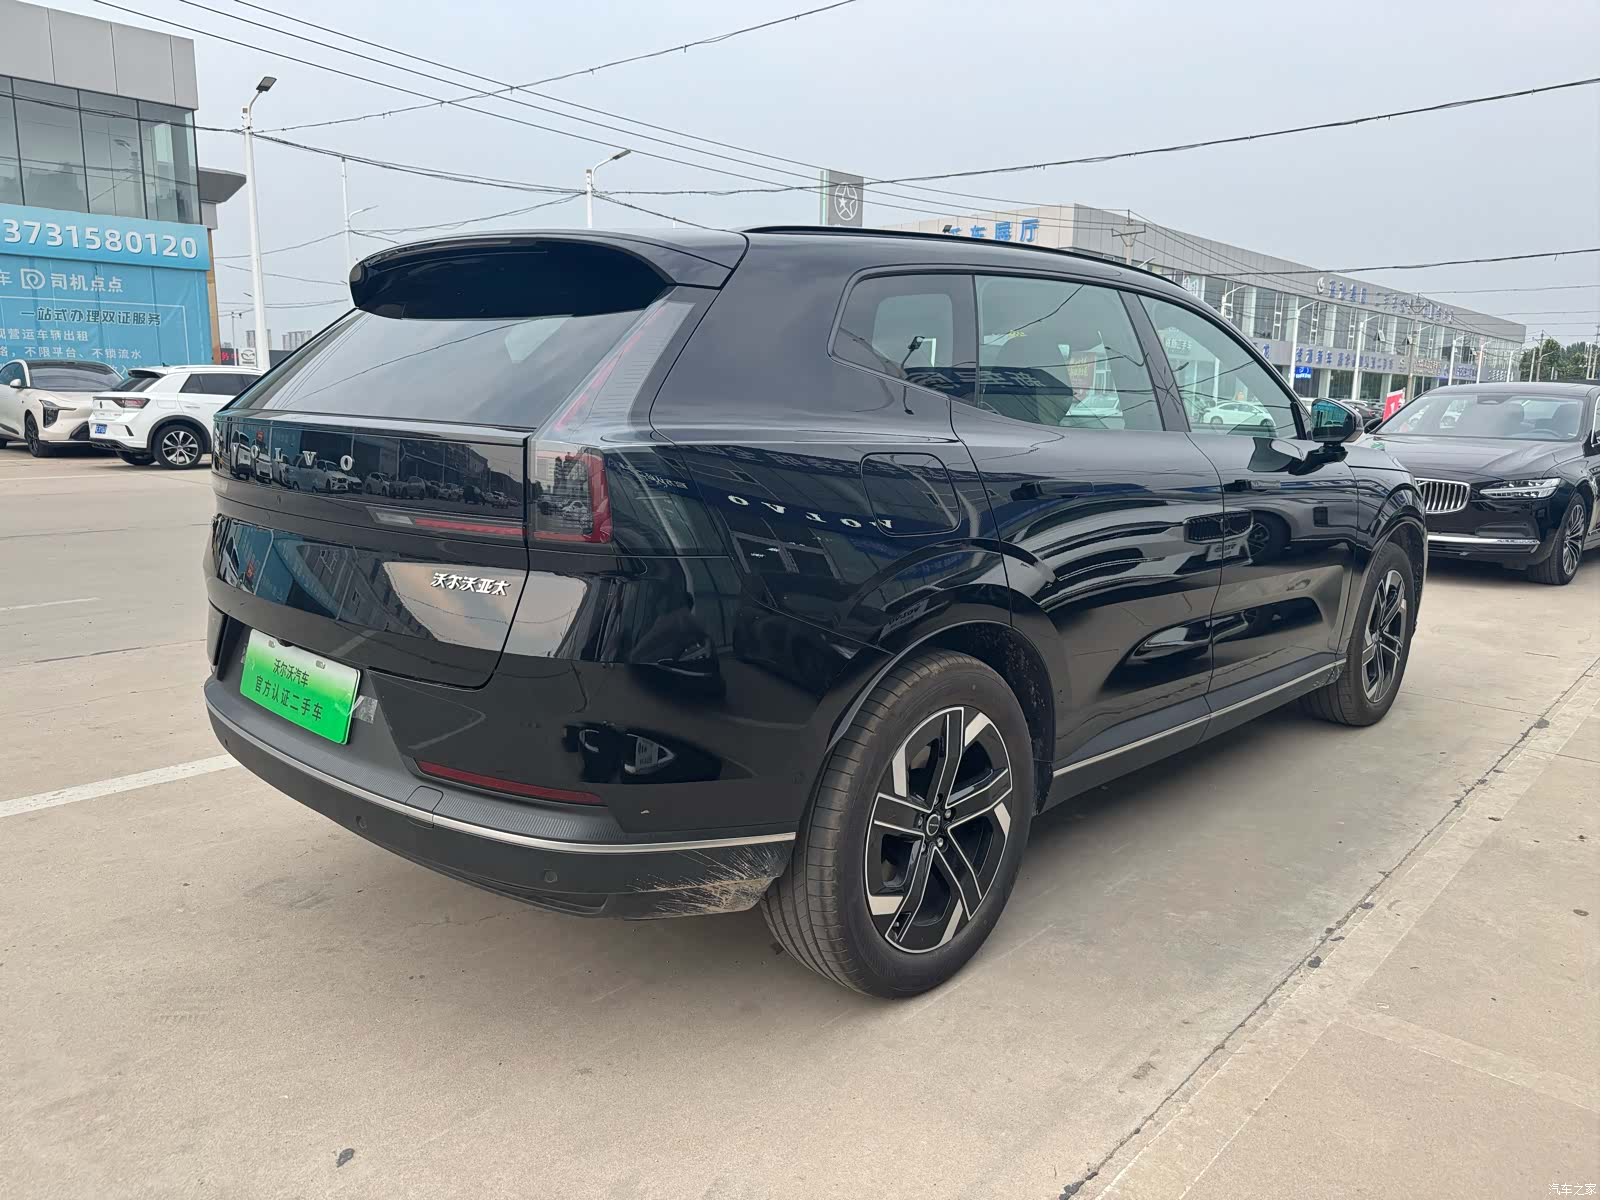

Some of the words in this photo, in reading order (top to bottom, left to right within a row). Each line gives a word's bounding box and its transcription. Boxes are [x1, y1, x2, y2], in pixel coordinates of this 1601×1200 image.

[3, 218, 198, 259] 3731580120
[51, 273, 124, 293] 司机点点
[21, 307, 162, 326] 一站式办理双证服务
[430, 572, 511, 596] 沃尔沃亚太
[273, 658, 310, 688] 沃尔沃汽车
[255, 674, 324, 722] 官方认证二手车
